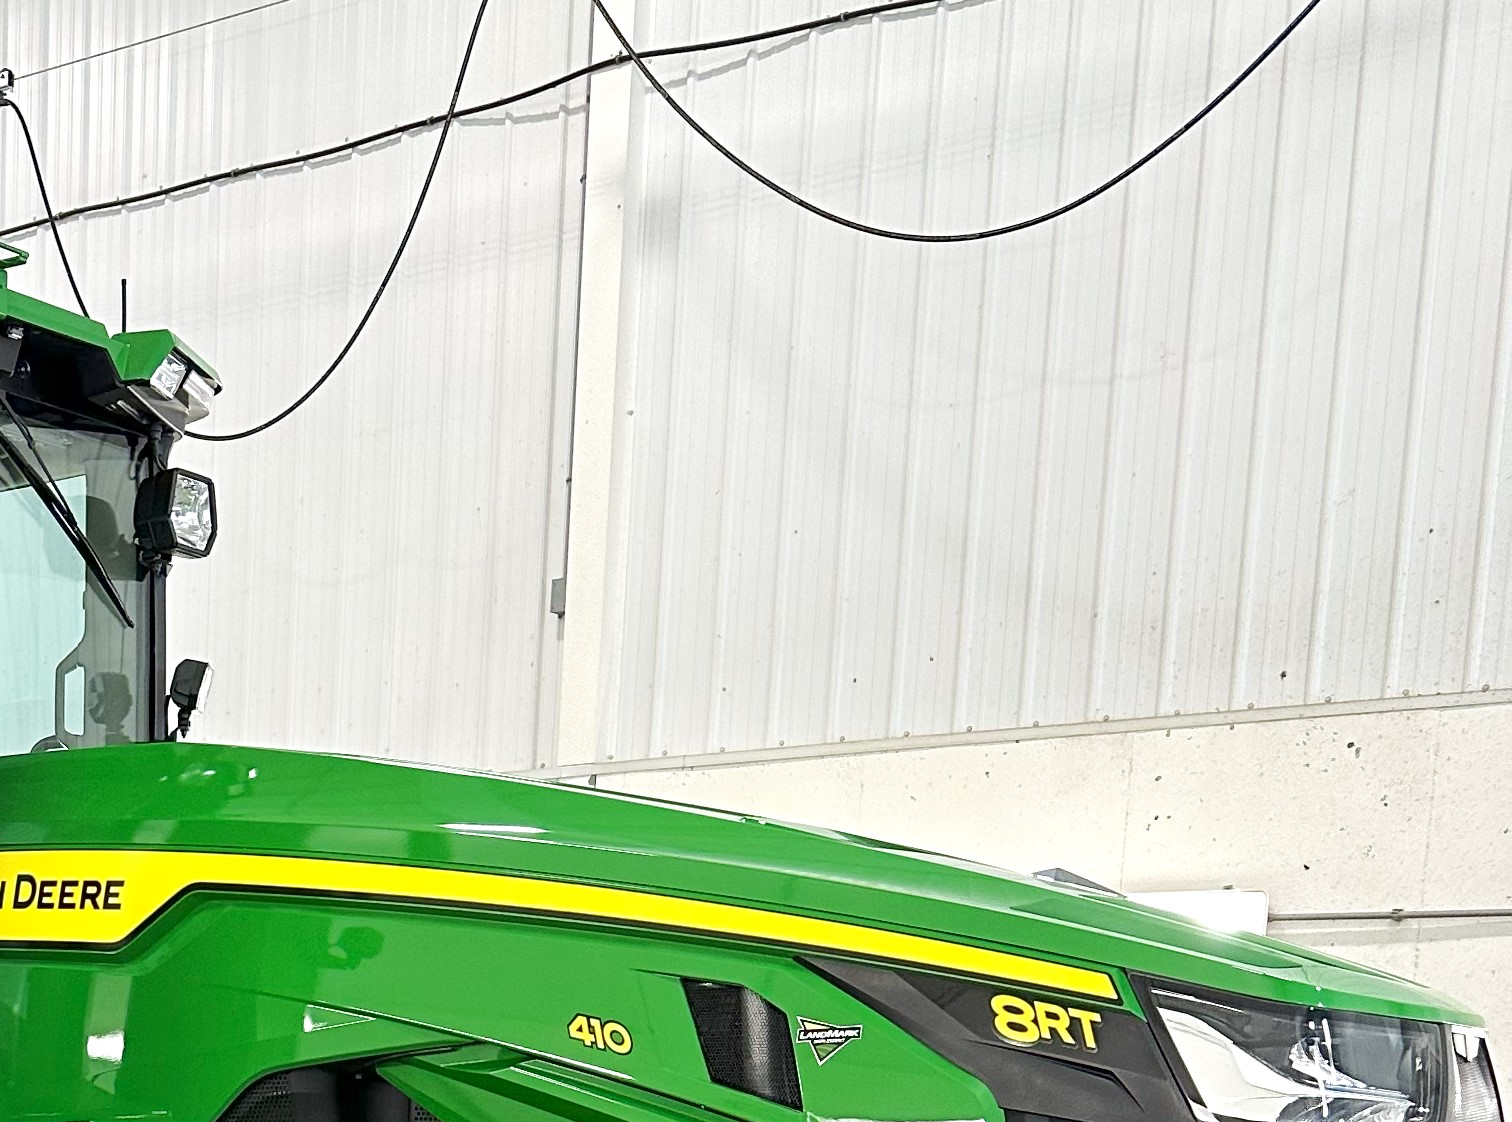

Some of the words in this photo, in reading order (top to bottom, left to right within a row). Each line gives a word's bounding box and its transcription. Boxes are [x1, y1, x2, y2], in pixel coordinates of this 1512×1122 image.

[12, 873, 125, 910] DEERE
[567, 1013, 633, 1056] 410
[990, 993, 1102, 1050] 8RT
